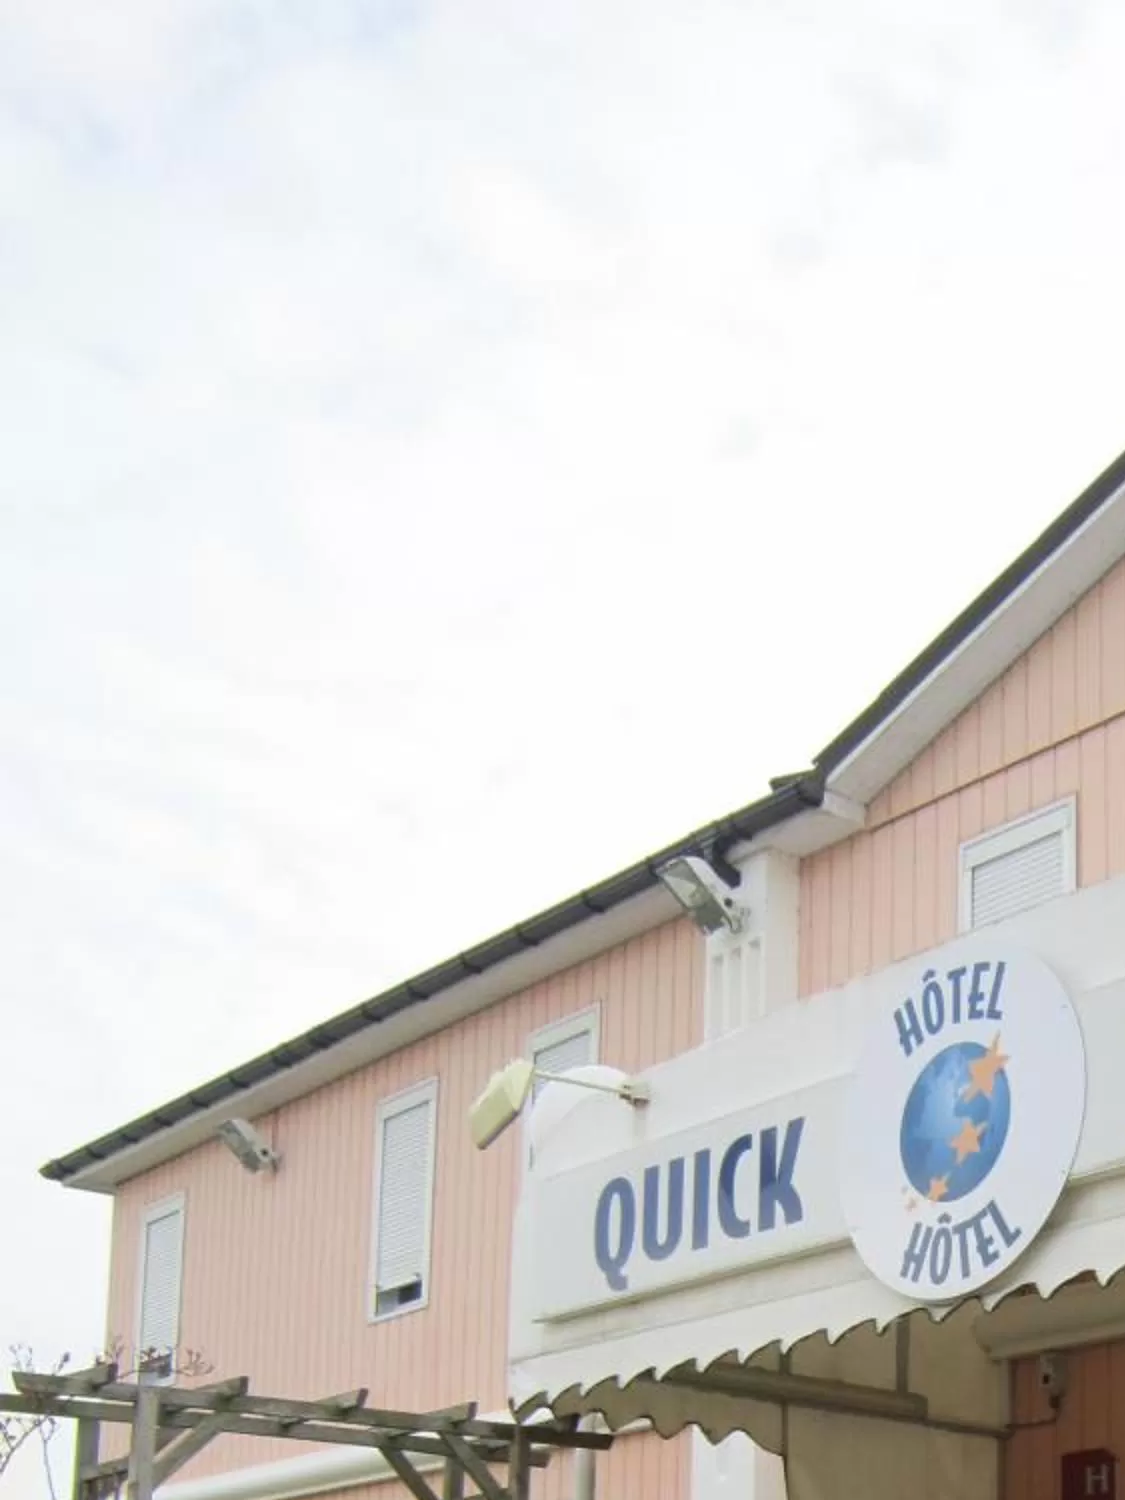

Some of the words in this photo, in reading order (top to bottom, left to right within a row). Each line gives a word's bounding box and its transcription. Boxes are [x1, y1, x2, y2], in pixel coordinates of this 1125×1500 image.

[894, 960, 1008, 1057] HÔTEL
[593, 1116, 806, 1291] QUICK
[899, 1199, 1022, 1286] HÔTEL
[1084, 1463, 1110, 1496] H
